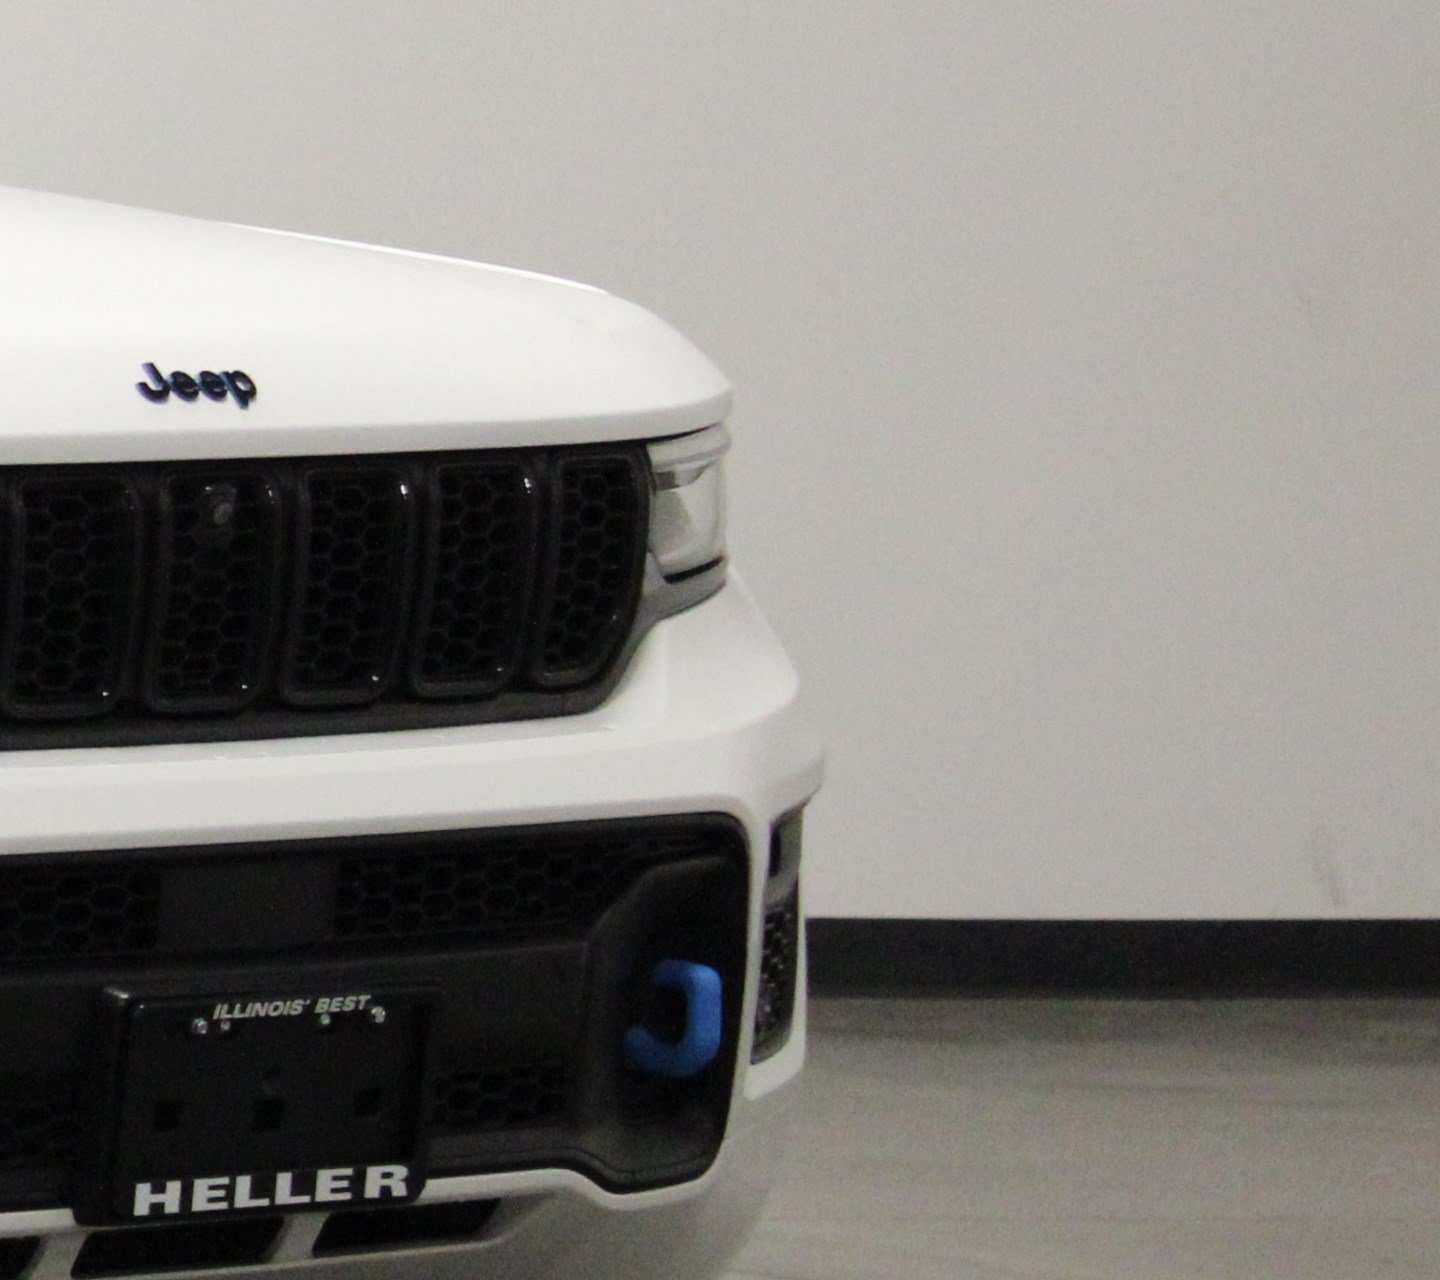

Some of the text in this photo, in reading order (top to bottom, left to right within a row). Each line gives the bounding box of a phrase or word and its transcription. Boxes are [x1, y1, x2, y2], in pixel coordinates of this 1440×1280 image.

[135, 361, 258, 410] Jeep
[313, 994, 373, 1014] BEST
[132, 1164, 410, 1217] HELLER
